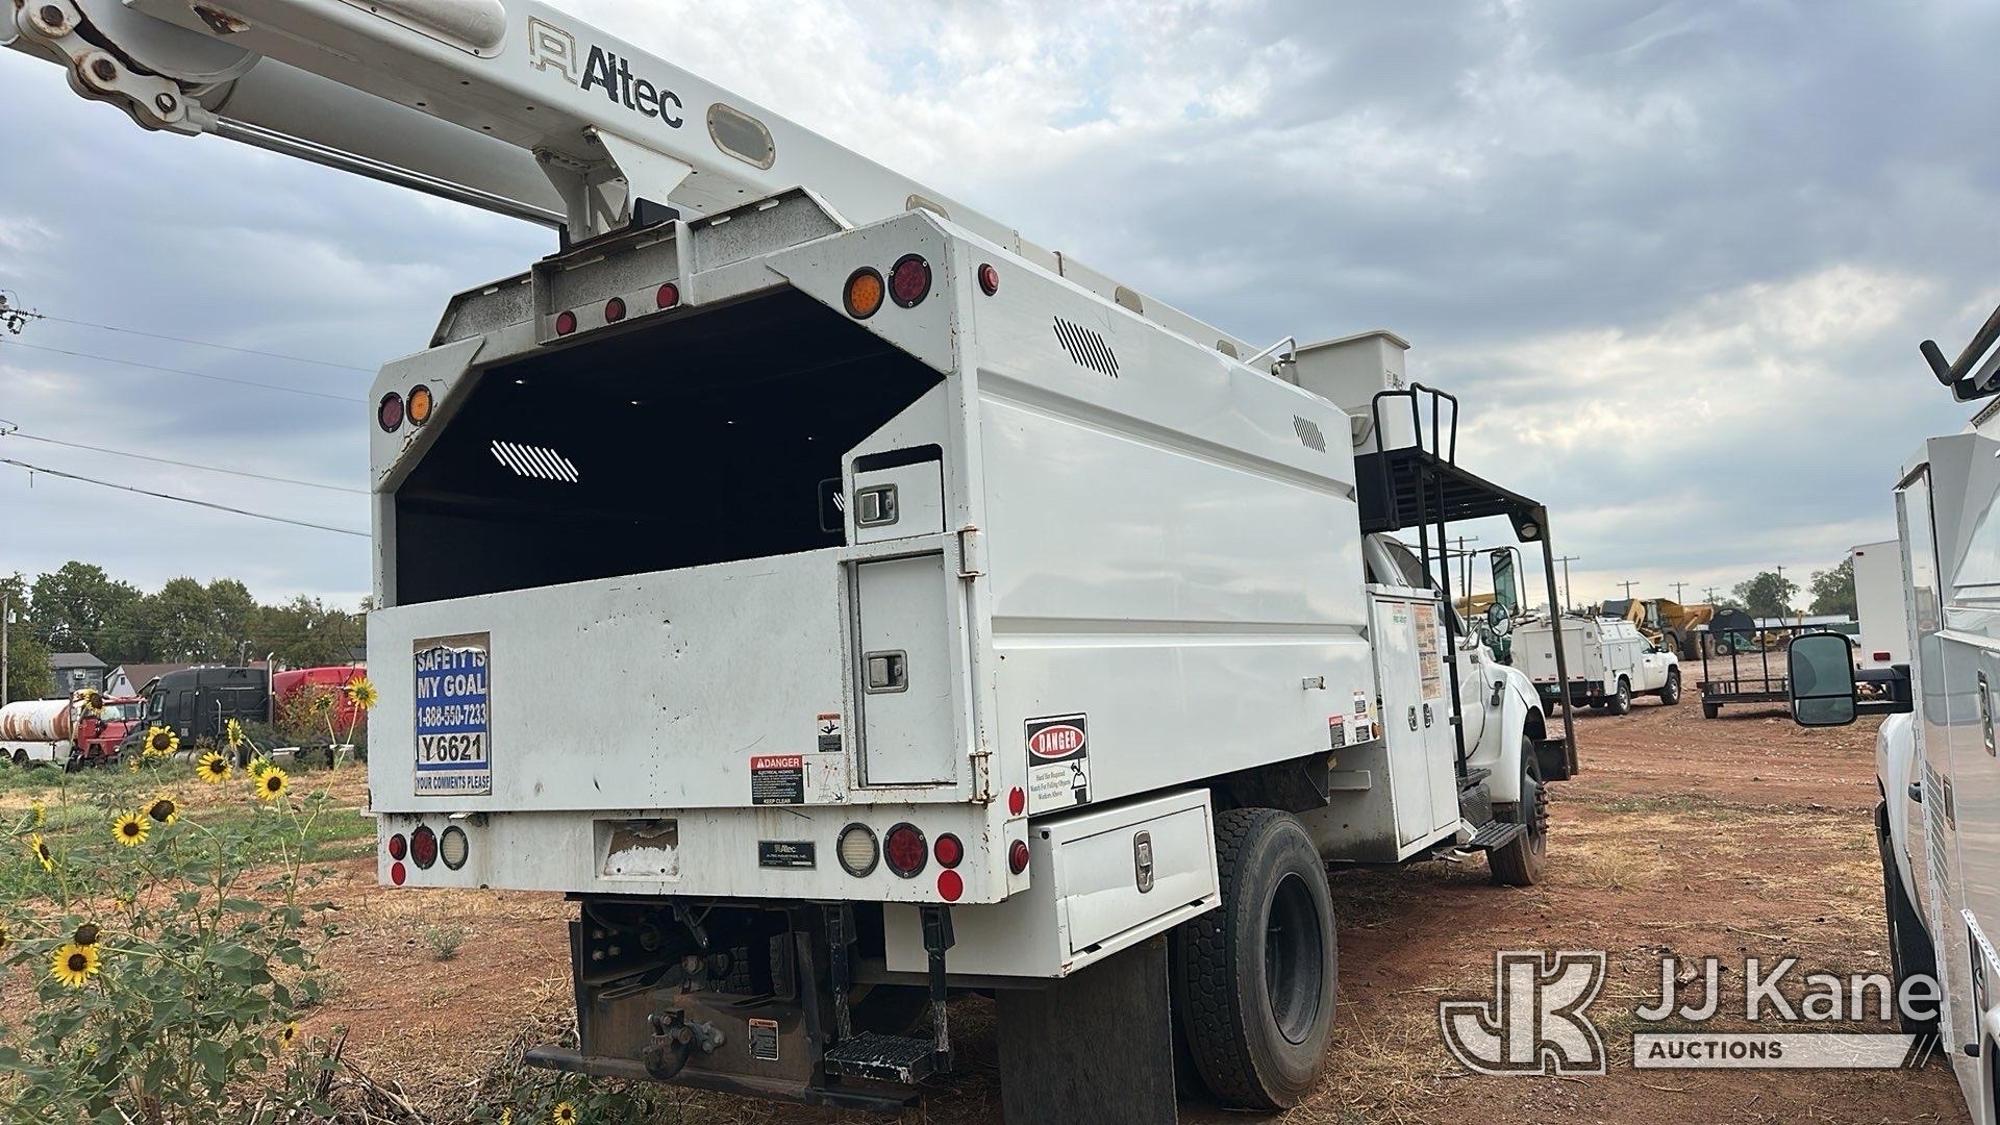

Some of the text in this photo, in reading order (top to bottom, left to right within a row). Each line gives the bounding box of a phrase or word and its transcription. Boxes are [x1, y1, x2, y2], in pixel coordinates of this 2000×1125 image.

[581, 45, 683, 128] Altec
[418, 673, 486, 699] MY GOAL
[418, 704, 486, 727] 1-888-550-7233
[422, 734, 481, 762] Y6621
[1039, 731, 1076, 753] DANGER
[764, 758, 800, 768] DANGER
[416, 775, 490, 790] YOUR COMMENTS PLEASE
